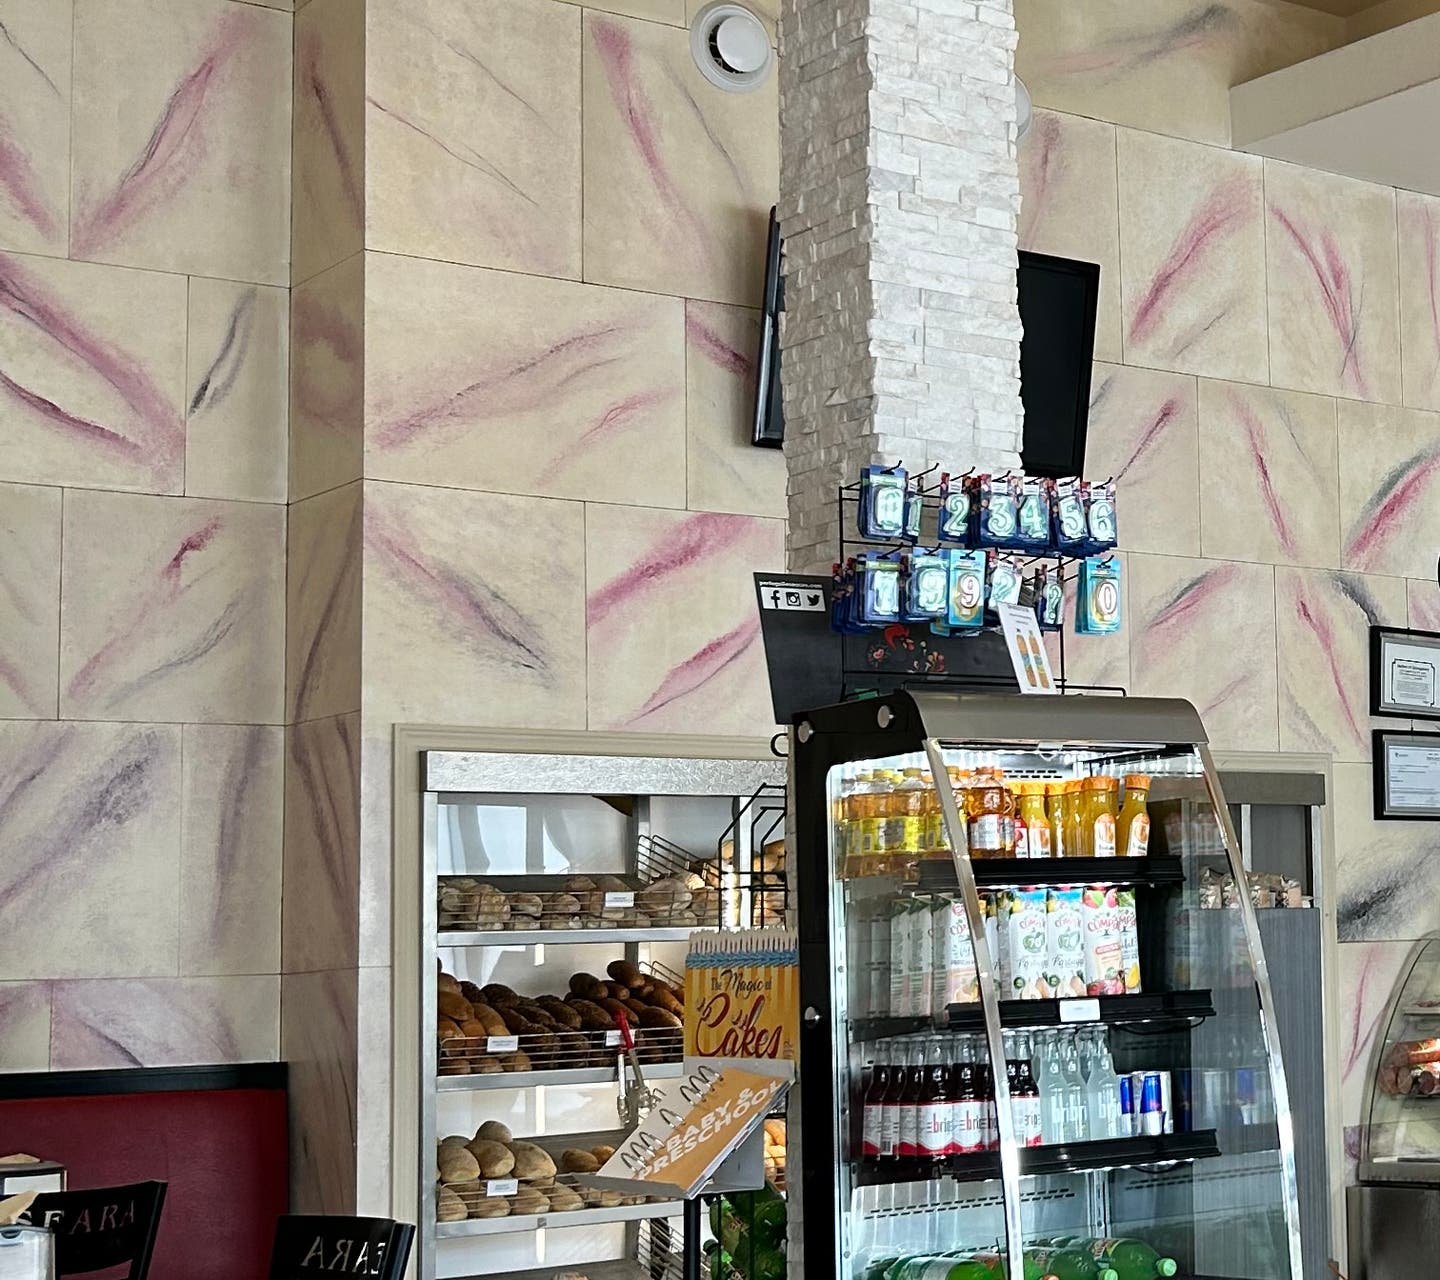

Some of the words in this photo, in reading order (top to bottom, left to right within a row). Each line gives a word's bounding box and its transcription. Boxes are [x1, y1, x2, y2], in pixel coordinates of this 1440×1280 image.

[944, 494, 970, 535] 2
[987, 495, 1016, 536] 3
[1018, 495, 1047, 537] 4
[1058, 495, 1086, 538] 5
[1088, 499, 1113, 541] 6
[958, 573, 980, 609] 9
[1098, 580, 1117, 615] 0
[721, 969, 764, 1000] Magic
[696, 992, 783, 1059] Cakes
[667, 1099, 732, 1153] BABY
[738, 1087, 754, 1107] &
